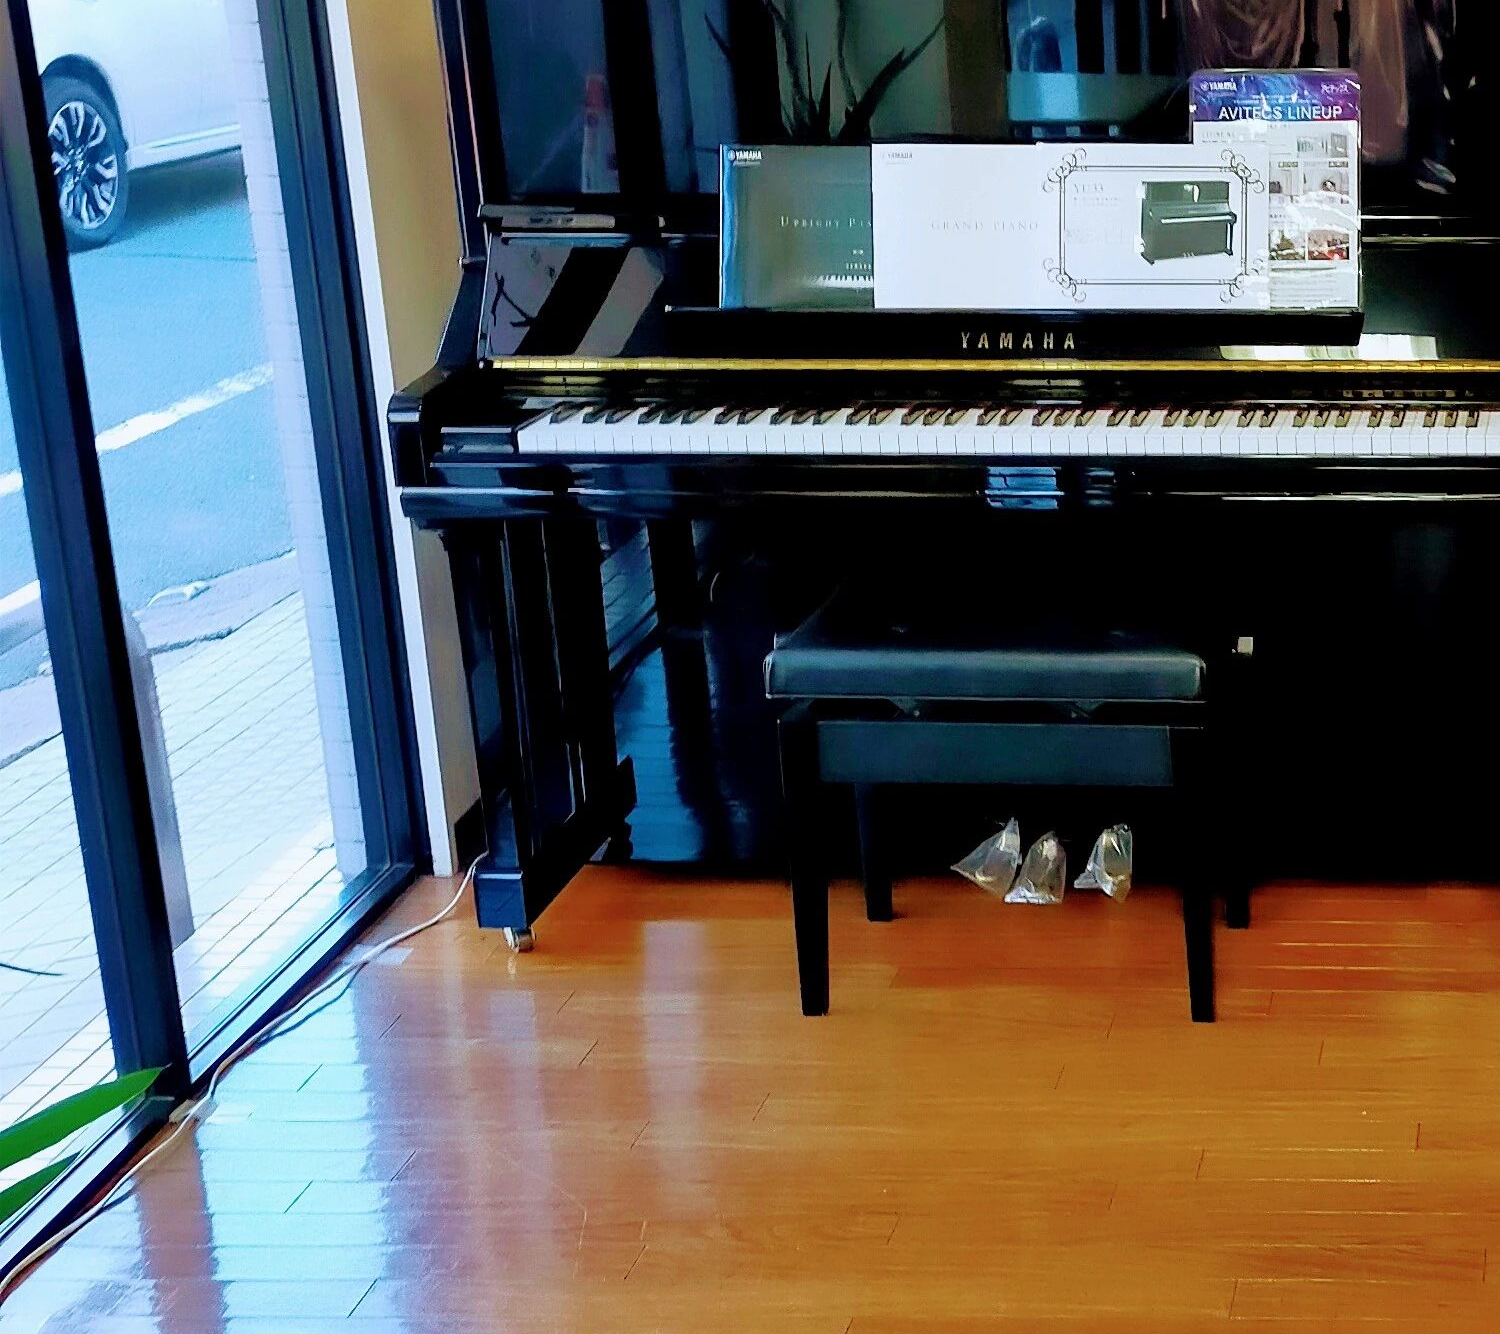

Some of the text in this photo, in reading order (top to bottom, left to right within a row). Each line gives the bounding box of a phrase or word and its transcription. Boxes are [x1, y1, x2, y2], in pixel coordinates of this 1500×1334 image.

[1209, 80, 1237, 91] YAMAHA
[1218, 105, 1343, 120] AVITECS LINEUP
[735, 150, 763, 161] YAMAHA
[930, 220, 1039, 231] GRAND PIANO
[961, 331, 1076, 350] YAMAHA
